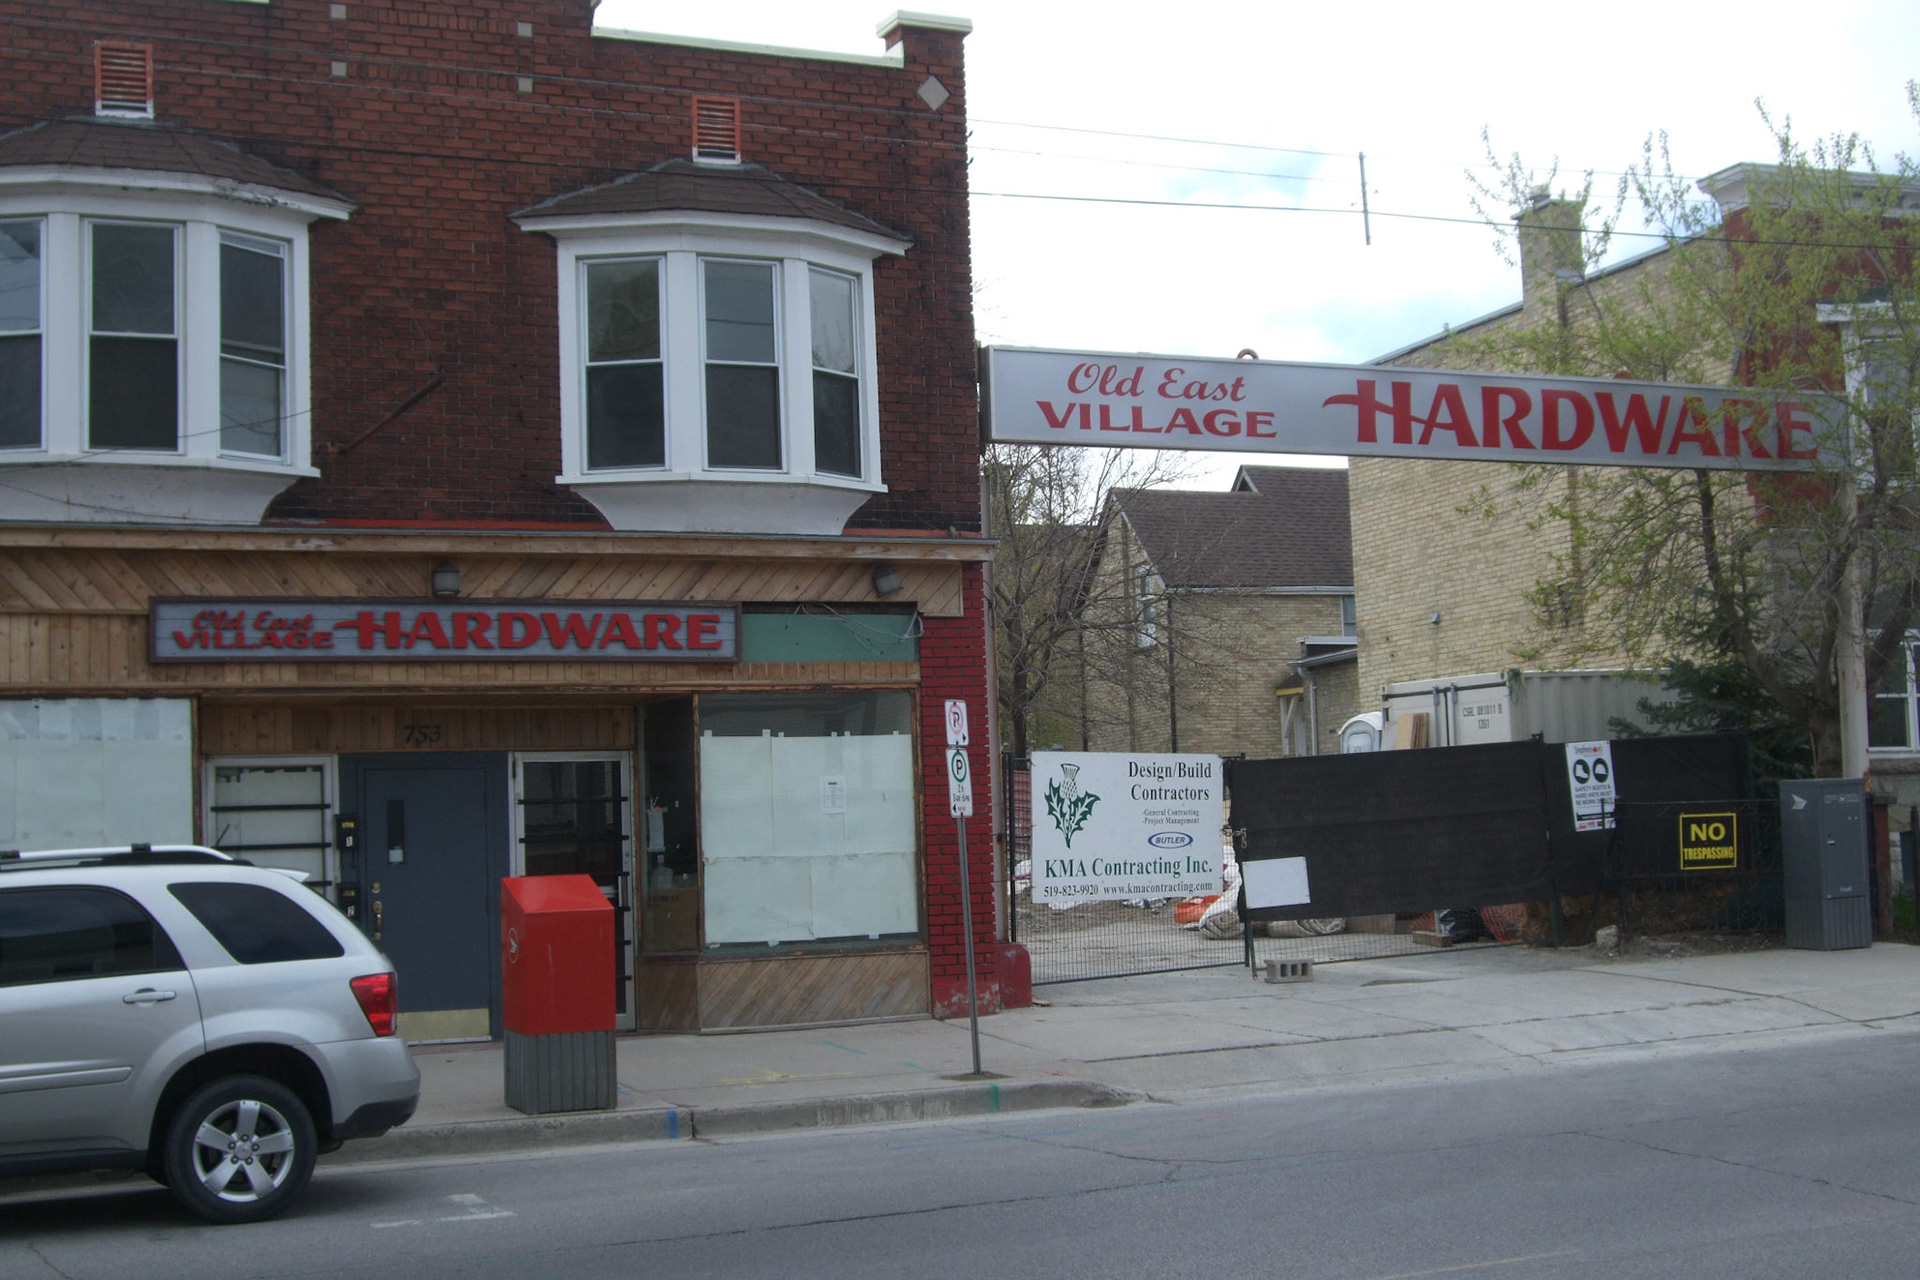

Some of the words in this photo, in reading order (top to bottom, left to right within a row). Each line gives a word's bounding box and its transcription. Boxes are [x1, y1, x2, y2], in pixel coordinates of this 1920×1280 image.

[1066, 362, 1145, 397] Old
[1157, 367, 1248, 402] East
[1036, 401, 1278, 438] VILLAGE
[1322, 379, 1819, 461] HARDWARE
[193, 609, 245, 631] Old
[252, 609, 313, 631] East
[172, 630, 335, 650] VILLAGE
[334, 610, 724, 651] HARDWARE
[404, 723, 442, 745] 753
[956, 759, 963, 775] P
[1128, 761, 1212, 782] Design/Build
[1131, 784, 1210, 801] Contractors
[1165, 817, 1200, 826] Management
[1167, 808, 1200, 818] Contracting
[1155, 836, 1186, 844] BUTLER
[1690, 822, 1726, 842] NO
[1683, 846, 1734, 861] TRESPASSING
[1045, 859, 1087, 878] KMA
[1092, 857, 1181, 879] Contracting
[1186, 856, 1213, 873] Inc.
[1043, 884, 1099, 897] 519-823-9920
[1103, 881, 1213, 895] www.kmacontracting.com
